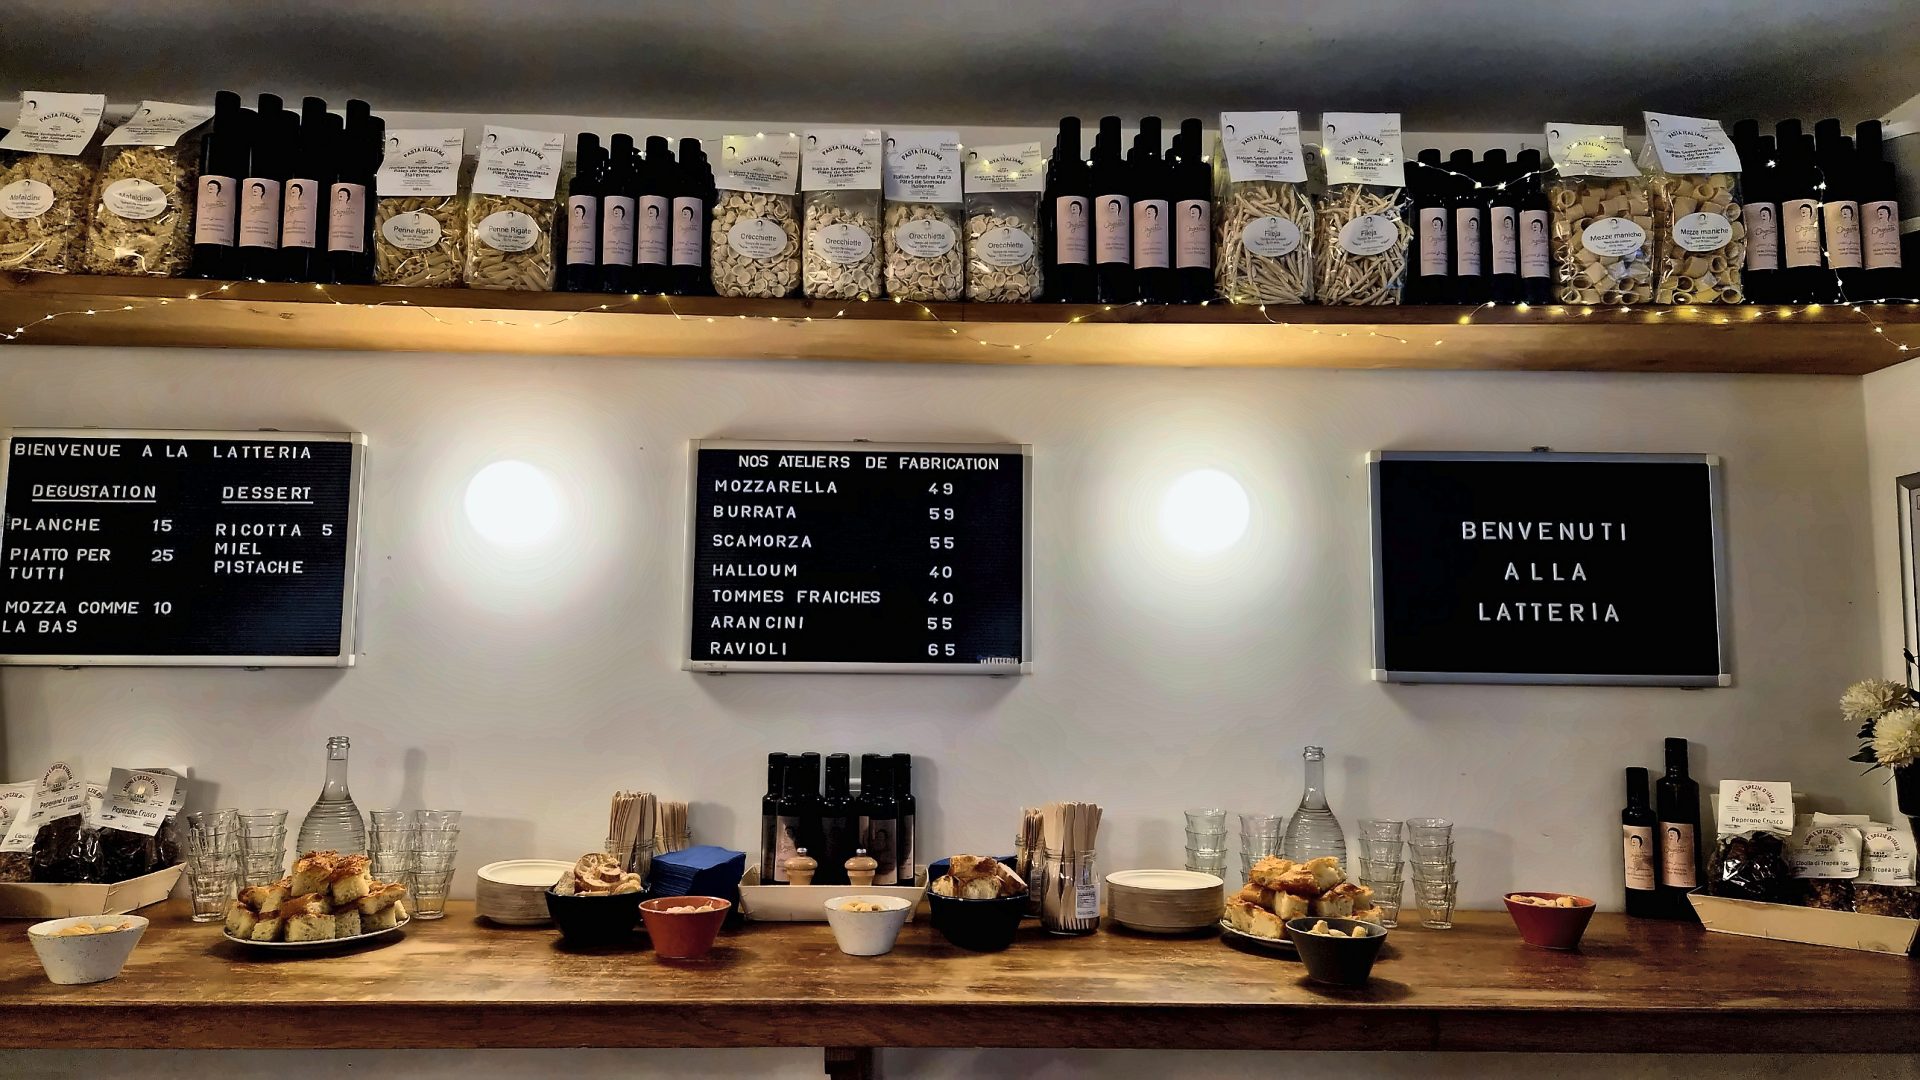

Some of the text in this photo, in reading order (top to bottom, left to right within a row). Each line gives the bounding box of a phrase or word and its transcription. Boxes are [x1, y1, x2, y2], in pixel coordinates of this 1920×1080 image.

[1241, 134, 1283, 146] PASTA ITALIANA
[1342, 135, 1358, 146] PASTA
[404, 148, 422, 158] PASTA
[501, 146, 544, 160] PASTA ITALIANA
[822, 145, 864, 156] PASTA ITALIANA
[901, 149, 943, 161] PASTA ITALIANA
[740, 156, 758, 165] PASTA
[393, 225, 414, 234] Penne
[488, 225, 531, 235] Penne Rigate
[740, 233, 777, 242] Orecchiette
[825, 238, 861, 246] Orecchiette
[988, 242, 1024, 250] Orecchiette
[14, 443, 311, 460] BIENVENUE A LA LATTERIA
[738, 454, 999, 470] NOS ATELIERS DE FABRICATION
[32, 484, 156, 499] DEGUSTATION
[222, 486, 311, 500] DESSERT
[715, 479, 953, 495] MOZZARELLA 49
[713, 505, 954, 521] BURRATA 59
[10, 517, 173, 532] PLANCHE 15
[215, 523, 333, 537] RICOTTA 5
[1461, 521, 1626, 541] BENVENUTI
[214, 542, 262, 556] MIEL
[712, 534, 954, 550] SCAMORZA 55
[10, 547, 174, 562] PIATTO PER 25
[9, 566, 64, 580] TUTTI
[214, 560, 304, 574] PISTACHE
[712, 563, 953, 579] HALLOUM 40
[1504, 561, 1587, 581] ALLA
[712, 589, 954, 605] TOMMES FRAICHES 40
[5, 600, 172, 615] MOZZA COMME 10
[1478, 602, 1620, 622] LATTERIA
[2, 619, 78, 633] LA BAS
[710, 615, 953, 631] ARANCINI 55
[710, 641, 956, 657] RAVIOLI 65
[112, 805, 157, 818] Peperone Crusco
